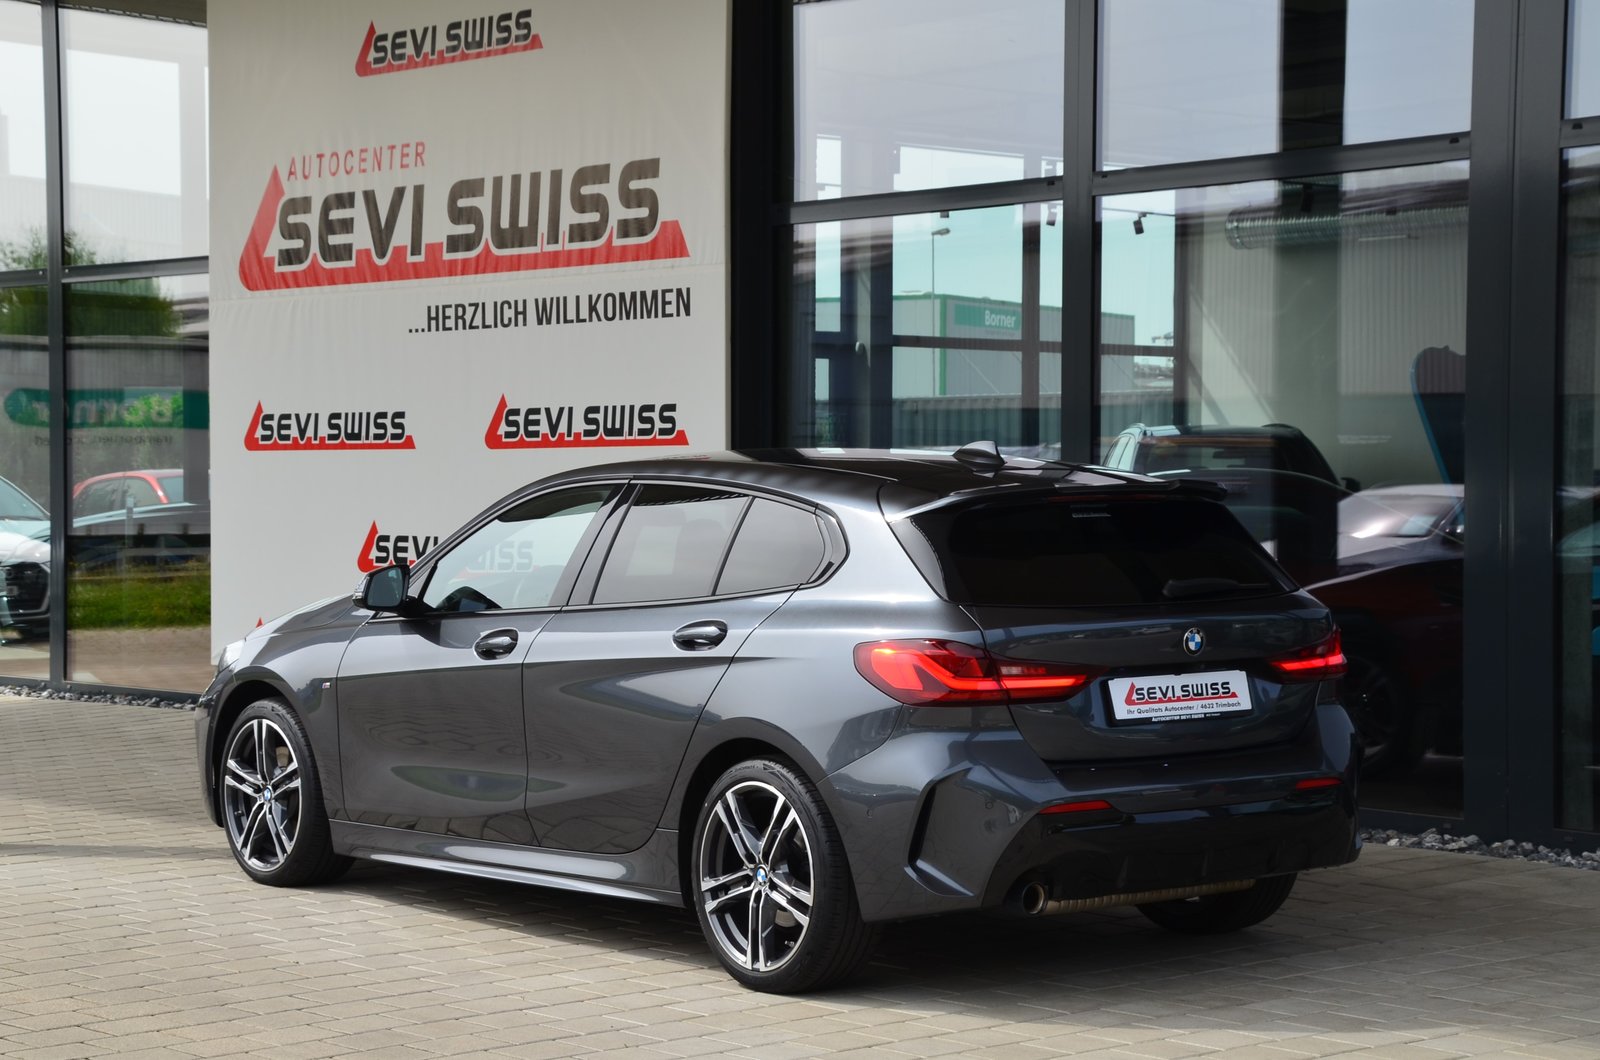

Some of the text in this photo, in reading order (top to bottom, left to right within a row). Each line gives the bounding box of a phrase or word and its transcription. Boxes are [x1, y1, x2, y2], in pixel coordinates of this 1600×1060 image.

[372, 9, 533, 66] SEVI SWISS
[287, 141, 426, 181] AUTOCENTER
[277, 157, 661, 268] SEVI SWISS
[408, 287, 692, 334] ...HERZLICH WILLKOMMEN
[984, 310, 1016, 327] Borner
[260, 410, 407, 443] SEVI SWISS
[503, 403, 678, 440] SEVI SWISS
[1135, 681, 1231, 701] SEVI SWISS
[1215, 701, 1241, 709] Trimbach
